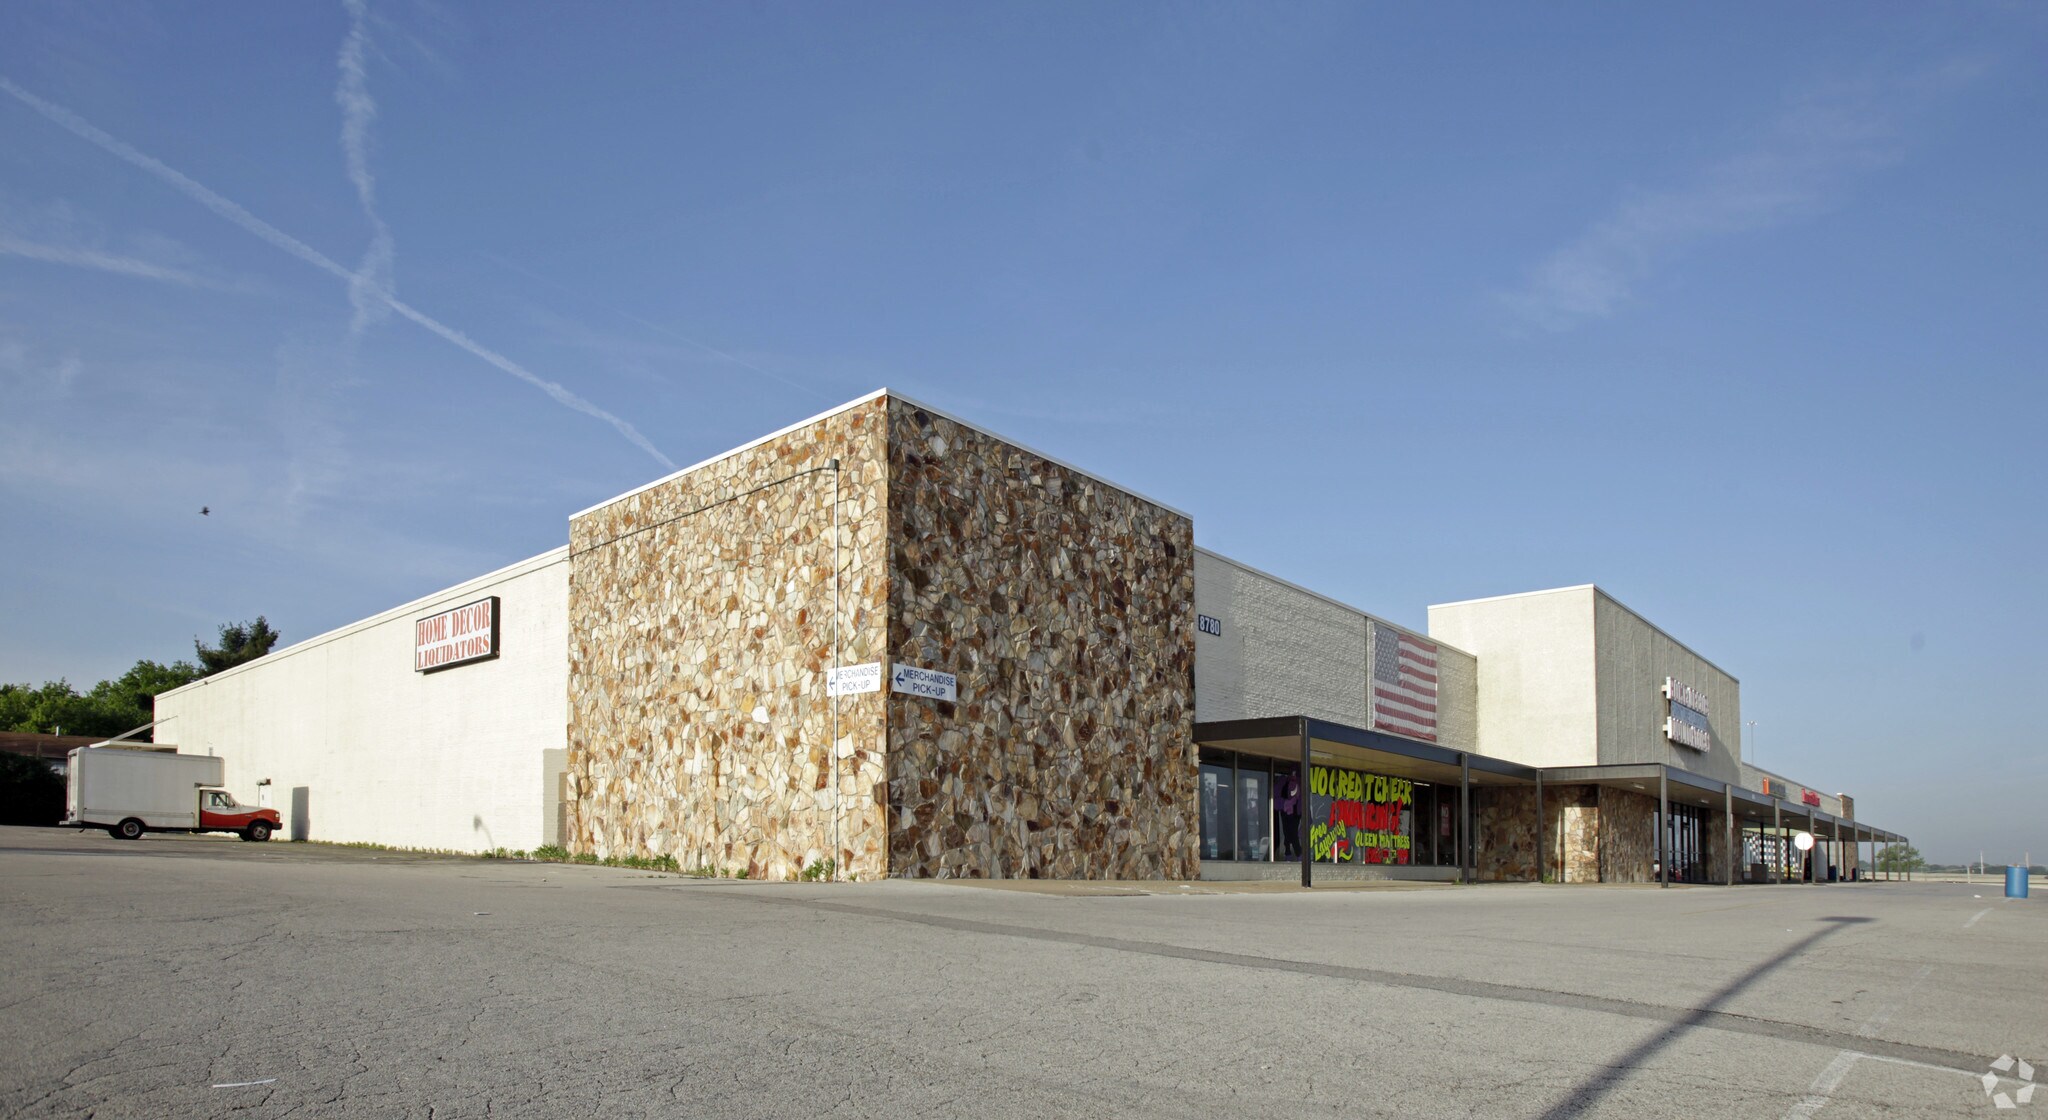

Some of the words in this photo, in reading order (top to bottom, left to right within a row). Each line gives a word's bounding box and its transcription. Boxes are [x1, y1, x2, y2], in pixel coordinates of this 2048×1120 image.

[417, 614, 448, 647] HOME
[451, 601, 490, 637] DECOR
[1199, 615, 1220, 635] 8780
[417, 633, 489, 669] LIQUIDATORS
[836, 665, 879, 680] MERCHANDISE
[903, 668, 955, 687] MERCHANDISE
[842, 680, 871, 691] PICK-UP
[912, 682, 946, 697] PICK-UP
[1374, 776, 1412, 806] CHECK
